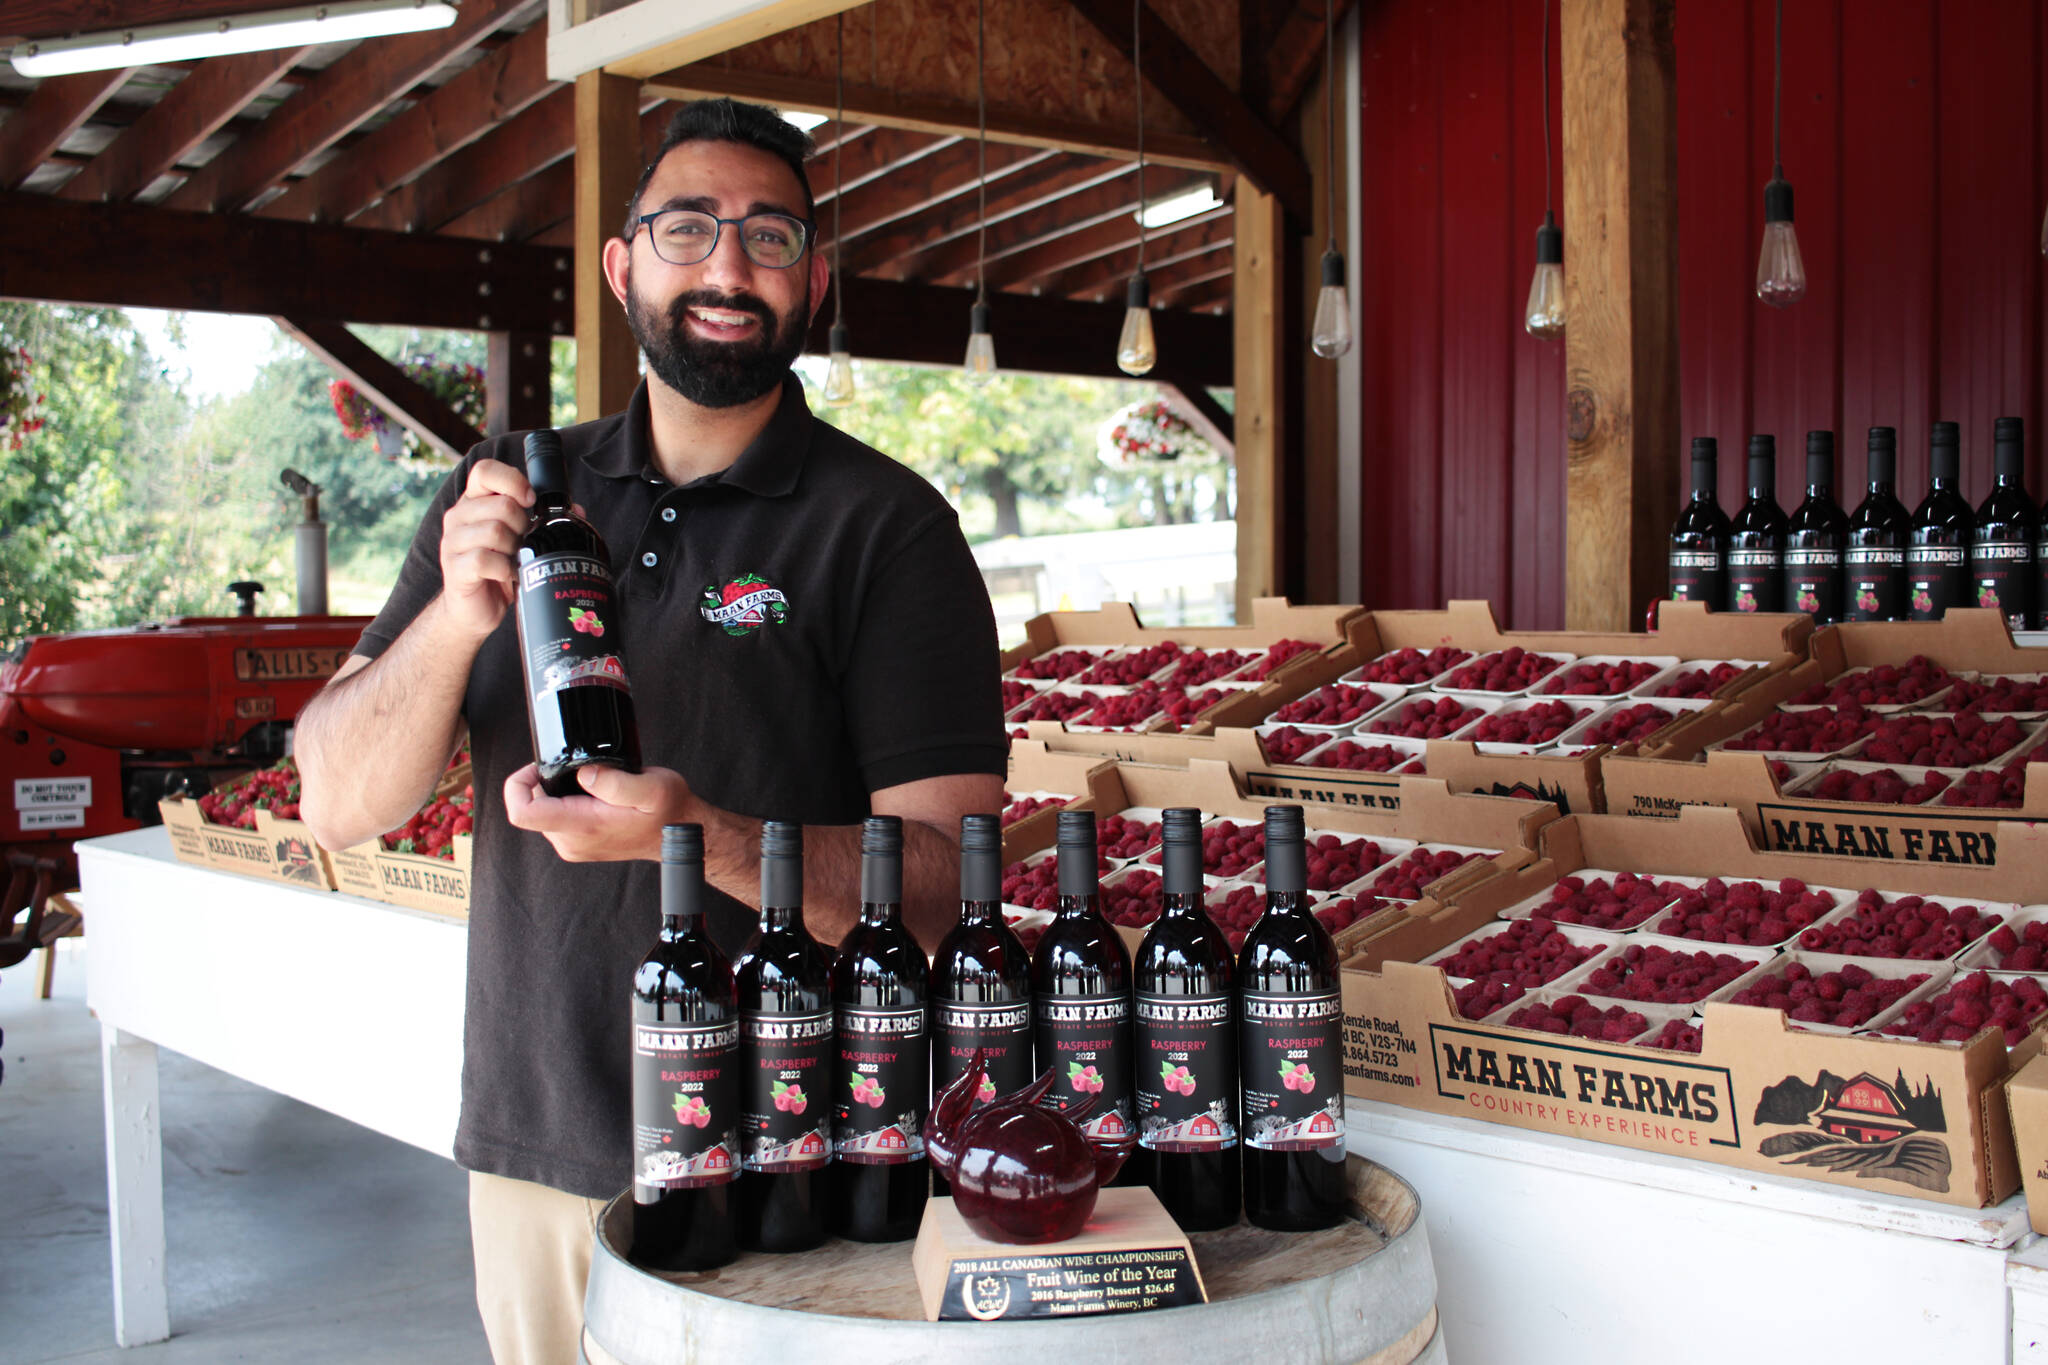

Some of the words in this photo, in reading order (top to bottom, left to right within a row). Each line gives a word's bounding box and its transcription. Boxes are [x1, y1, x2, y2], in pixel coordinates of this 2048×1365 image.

[1747, 554, 1776, 565] FARM
[1784, 553, 1807, 565] AAN
[1808, 553, 1838, 565] FARM
[1845, 552, 1866, 563] AAN
[1921, 551, 1960, 562] FARMS
[1987, 547, 2027, 558] FARMS
[1681, 556, 1716, 567] FARMS
[527, 561, 578, 584] MAAN
[581, 561, 610, 580] FAR
[713, 603, 743, 620] MAAN
[746, 591, 781, 606] FARMS
[254, 651, 346, 674] ALLIS-C
[1342, 793, 1400, 809] FAR
[1633, 795, 1652, 808] 790
[207, 836, 238, 857] MAAN
[236, 841, 271, 864] FARMS
[1771, 819, 1894, 859] MAAN
[1900, 828, 1997, 866] FAR
[381, 864, 422, 890] MAAN
[424, 871, 466, 899] FARMS
[1136, 1001, 1174, 1021] MAAN
[1177, 1003, 1228, 1021] FARMS
[1247, 1000, 1293, 1018] MAAN
[1297, 999, 1339, 1018] FARMS
[869, 1016, 920, 1033] FARMS
[938, 1010, 975, 1028] AAN
[979, 1009, 1027, 1027] FARMS
[1342, 1012, 1372, 1029] Kenzie
[1373, 1017, 1403, 1038] Road,
[747, 1022, 788, 1039] AAN
[792, 1017, 833, 1039] FARMS
[638, 1031, 689, 1050] MAAN
[693, 1028, 738, 1049] FARMS
[1057, 1039, 1113, 1051] RASPBERRY
[1151, 1039, 1207, 1051] RASPBERRY
[1268, 1037, 1324, 1049] RASPBERRY
[1350, 1029, 1368, 1048] BC,
[1369, 1033, 1417, 1054] V2S-7N4
[841, 1049, 898, 1064] RASPBERRY
[950, 1046, 1008, 1057] RASPERRY
[1075, 1052, 1096, 1061] 2022
[1167, 1052, 1188, 1061] 2022
[1287, 1050, 1308, 1059] 2022
[1343, 1046, 1398, 1067] 4.864.5723
[760, 1058, 818, 1070] RASPBERRY
[857, 1063, 879, 1073] 2022
[661, 1069, 721, 1081] RASPBERRY
[780, 1071, 801, 1080] 2022
[1343, 1064, 1415, 1088] aanfarms.com
[1443, 1043, 1567, 1100] MAAN
[1574, 1064, 1719, 1123] FARMS
[681, 1082, 704, 1091] 2022
[1470, 1092, 1558, 1122] COUNTRY
[1567, 1109, 1699, 1146] EXPERIENCE
[954, 1261, 977, 1274] 2018
[978, 1260, 1001, 1272] ALL
[1002, 1257, 1062, 1270] CANADIAN
[1064, 1255, 1093, 1267] WINE
[1096, 1250, 1185, 1265] CHAMPIONSHIPS
[1027, 1271, 1061, 1287] Fruit
[1064, 1269, 1100, 1285] Wine
[1104, 1268, 1119, 1282] of
[1122, 1267, 1142, 1282] the
[1145, 1265, 1177, 1280] Year
[1031, 1290, 1053, 1302] 2016
[1055, 1288, 1104, 1301] Raspberry
[1106, 1285, 1141, 1296] Dessert
[1145, 1283, 1175, 1294] $26.45
[1050, 1302, 1075, 1313] Maan
[1077, 1301, 1106, 1312] Farms
[1107, 1299, 1141, 1310] Winery,
[1143, 1297, 1158, 1307] BC
